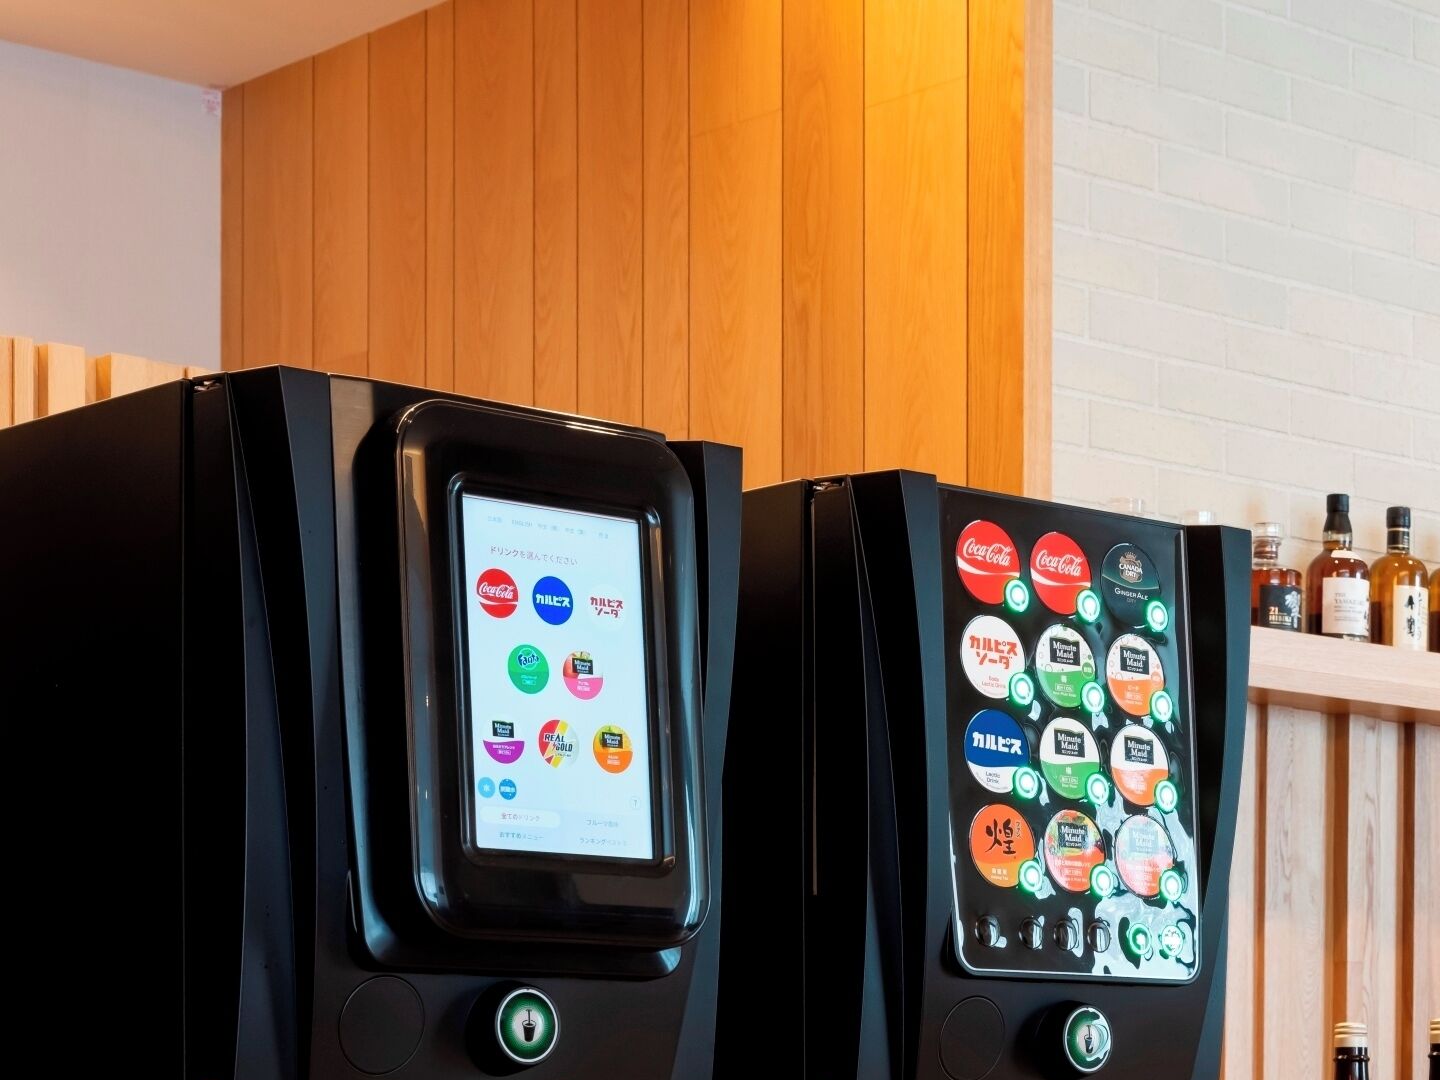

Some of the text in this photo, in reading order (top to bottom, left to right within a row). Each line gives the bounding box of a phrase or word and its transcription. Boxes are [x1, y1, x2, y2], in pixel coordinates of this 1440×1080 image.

[490, 546, 577, 566] ドリンクを選んでください
[962, 537, 1013, 567] Coca-Cola
[1035, 549, 1084, 577] Coca-Cola
[1118, 563, 1143, 575] CANADA
[478, 581, 515, 600] Coca-Cola
[535, 593, 571, 608] カルピス
[590, 596, 624, 610] カルピス
[594, 607, 621, 619] ソーダ
[969, 634, 1018, 656] カルピス
[1052, 640, 1078, 652] Minute
[1056, 650, 1075, 659] Maid
[1123, 649, 1147, 661] Minute
[975, 652, 1013, 670] ソーダ
[1126, 657, 1144, 668] Maid
[544, 732, 566, 743] REAL
[972, 731, 1022, 755] カルピス
[1057, 732, 1082, 745] Minute
[555, 743, 573, 752] GOLD
[1060, 740, 1079, 751] Maid
[1127, 739, 1151, 751] Minute
[1130, 747, 1149, 758] Maid
[1060, 824, 1086, 836] Minute
[985, 818, 1017, 855] 煌
[1064, 833, 1083, 843] Maid
